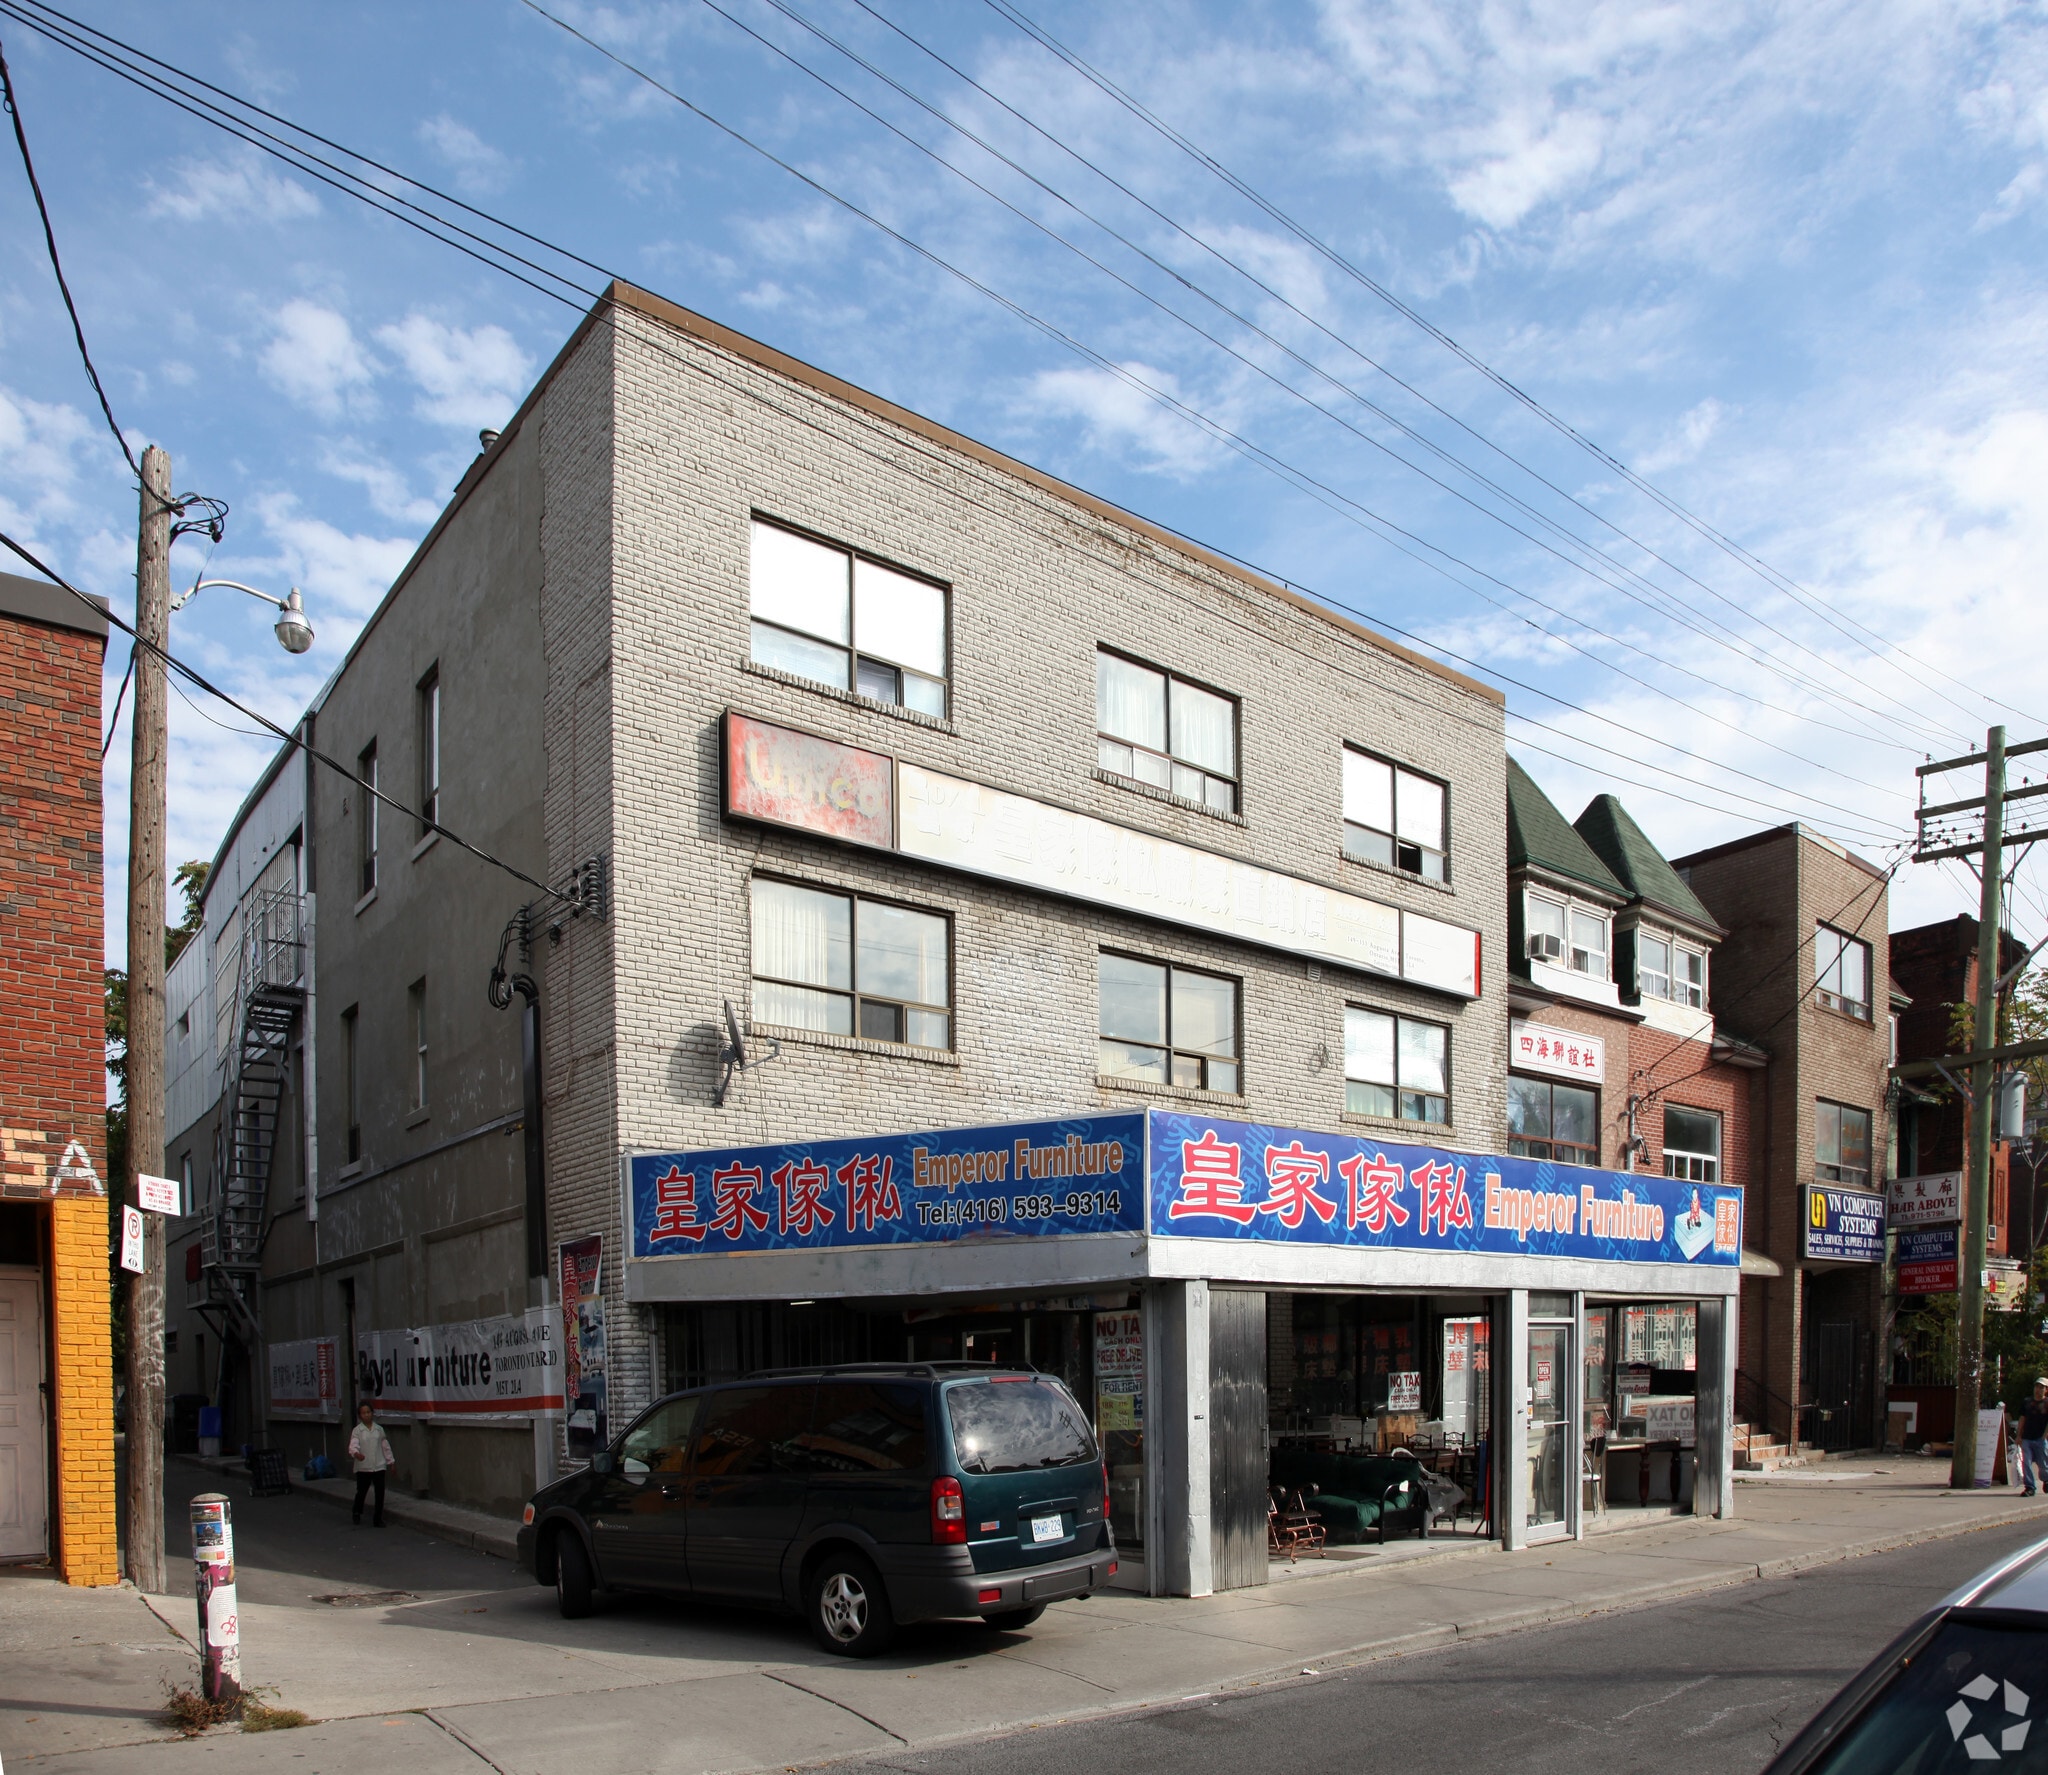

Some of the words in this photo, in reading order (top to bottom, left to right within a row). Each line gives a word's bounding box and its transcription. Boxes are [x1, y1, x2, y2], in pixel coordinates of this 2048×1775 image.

[913, 1146, 1008, 1193] Emperor
[1014, 1134, 1124, 1181] Furniture
[1168, 1128, 1474, 1237] 皇家傢俬
[649, 1152, 903, 1243] 皇家傢俬
[1917, 1197, 1957, 1211] ABOVE
[916, 1197, 1007, 1226] Tel:(416)
[1013, 1189, 1121, 1220] 593-9314
[1484, 1173, 1577, 1242] Emperor
[1580, 1184, 1664, 1242] Furniture
[1827, 1193, 1841, 1213] VN
[1843, 1195, 1884, 1219] COMPUTER
[1839, 1215, 1877, 1236] SYSTEMS
[1808, 1232, 1823, 1245] SALES,
[1901, 1235, 1912, 1245] VN
[1912, 1231, 1954, 1244] COMPUTER
[1912, 1243, 1943, 1254] SYSTEMS
[1901, 1266, 1924, 1276] GENERAL
[1925, 1264, 1954, 1274] INSURANCE
[1914, 1275, 1940, 1284] BROKER
[1096, 1315, 1118, 1337] NO
[1122, 1313, 1142, 1335] TA
[1104, 1337, 1124, 1345] CASH
[1104, 1382, 1121, 1393] FOR
[1390, 1375, 1402, 1388] NO
[1403, 1374, 1420, 1387] TAX
